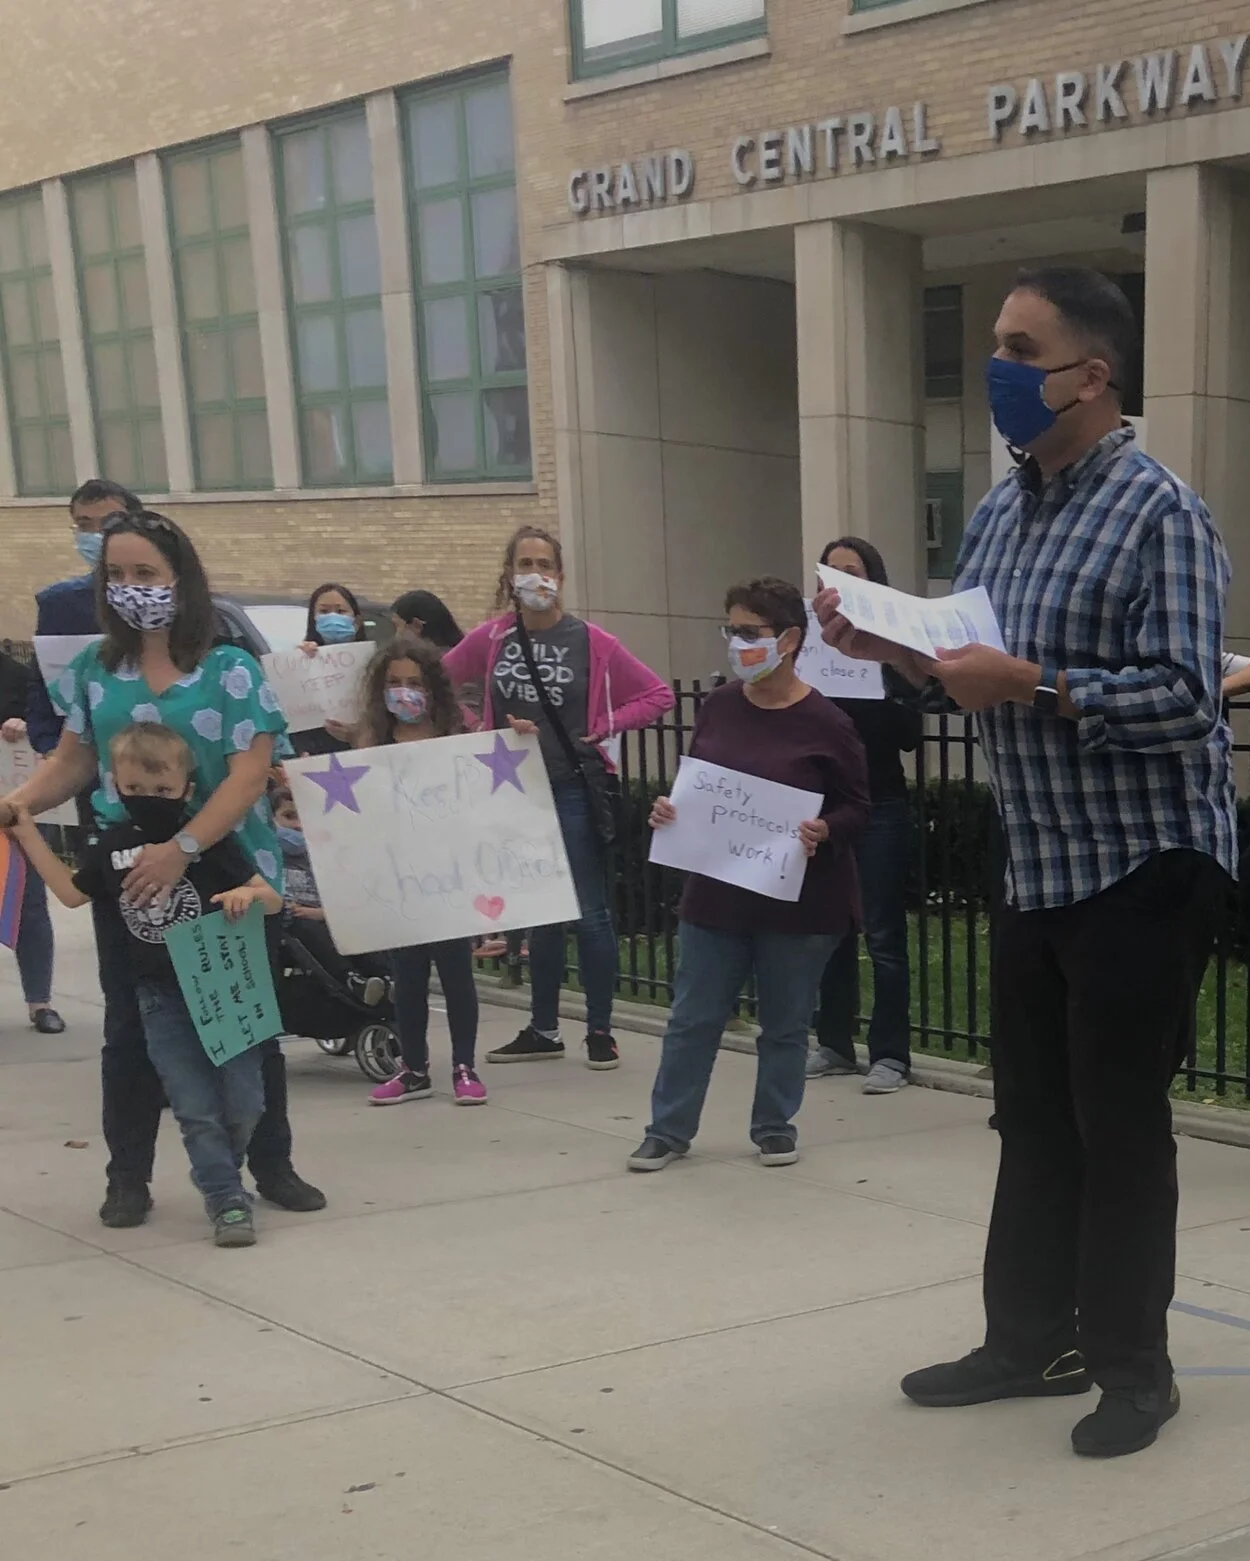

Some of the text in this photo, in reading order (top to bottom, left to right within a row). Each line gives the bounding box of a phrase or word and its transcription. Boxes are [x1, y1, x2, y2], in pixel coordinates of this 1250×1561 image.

[568, 149, 693, 213] GRAND
[731, 101, 940, 186] CENTRAL
[494, 661, 574, 683] GOOD
[497, 680, 564, 706] VIBS
[693, 771, 752, 806] Safety
